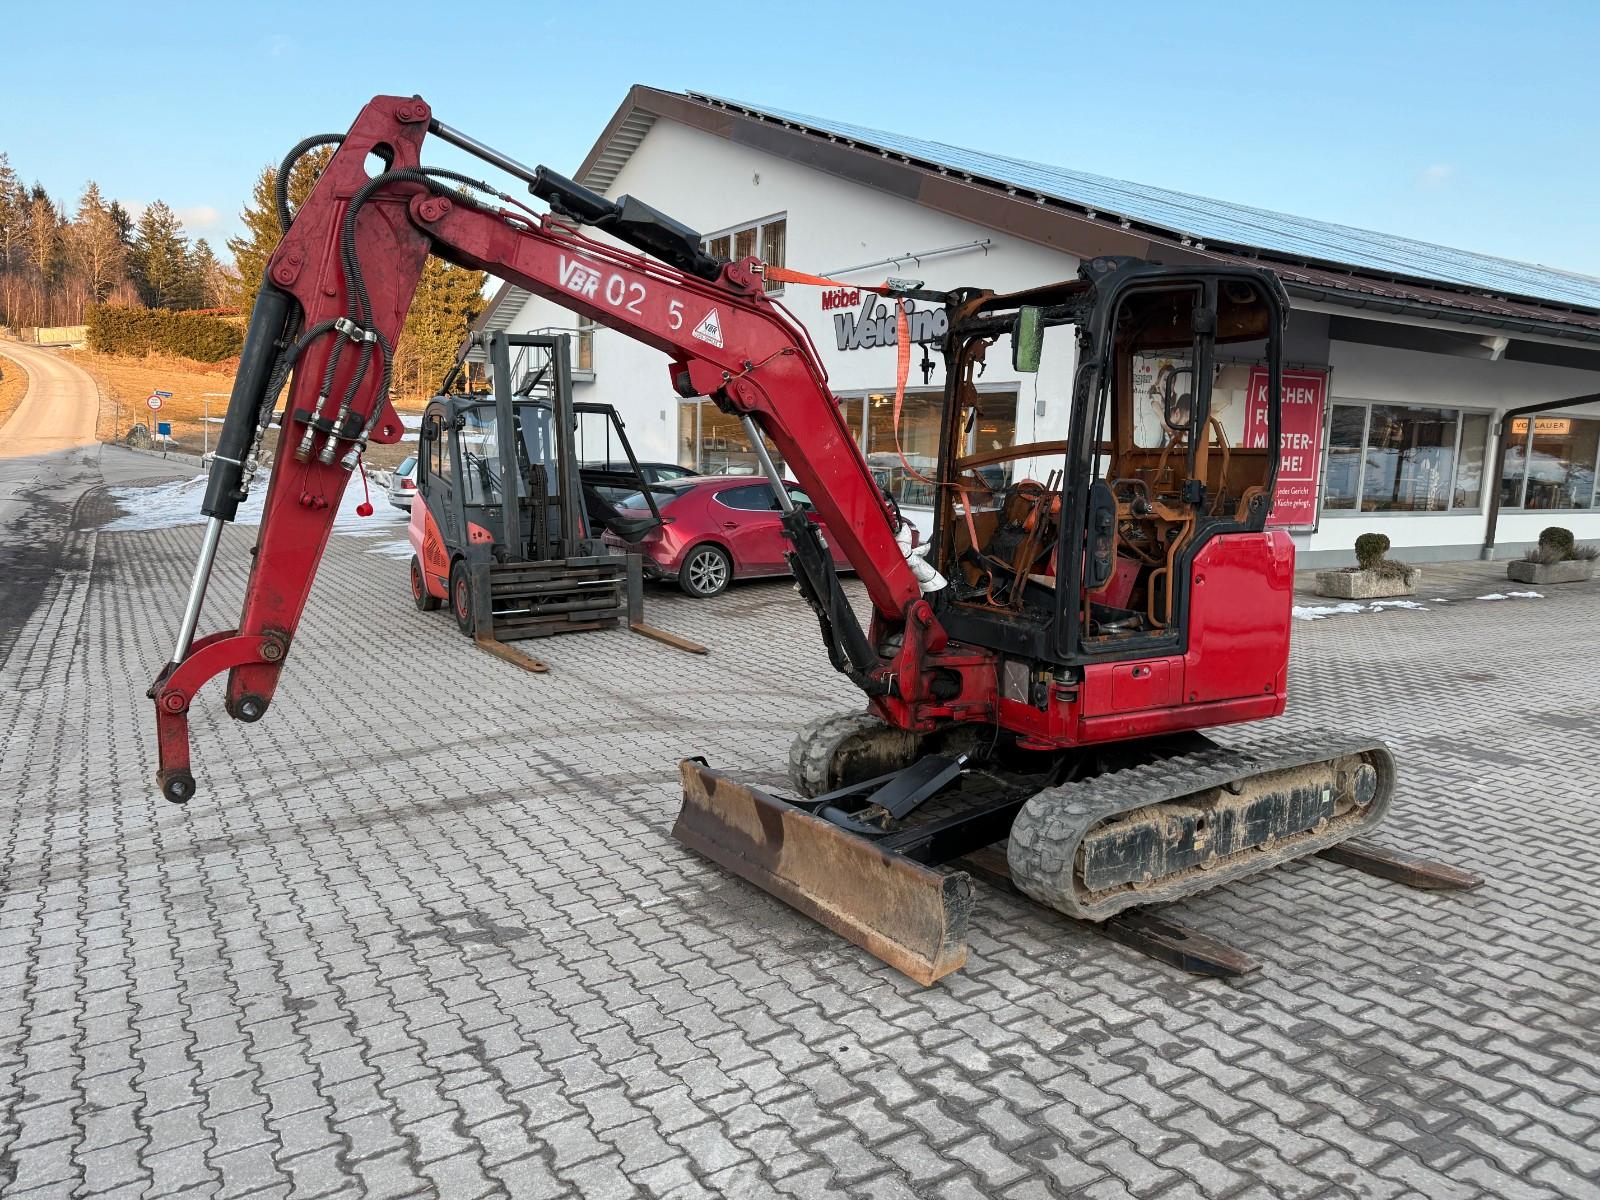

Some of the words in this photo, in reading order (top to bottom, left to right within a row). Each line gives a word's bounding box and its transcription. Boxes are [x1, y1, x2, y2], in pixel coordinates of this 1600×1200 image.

[559, 254, 602, 299] VBR
[822, 288, 860, 310] Möbel
[1258, 385, 1314, 404] KCHEN
[1254, 432, 1313, 450] MSTER-
